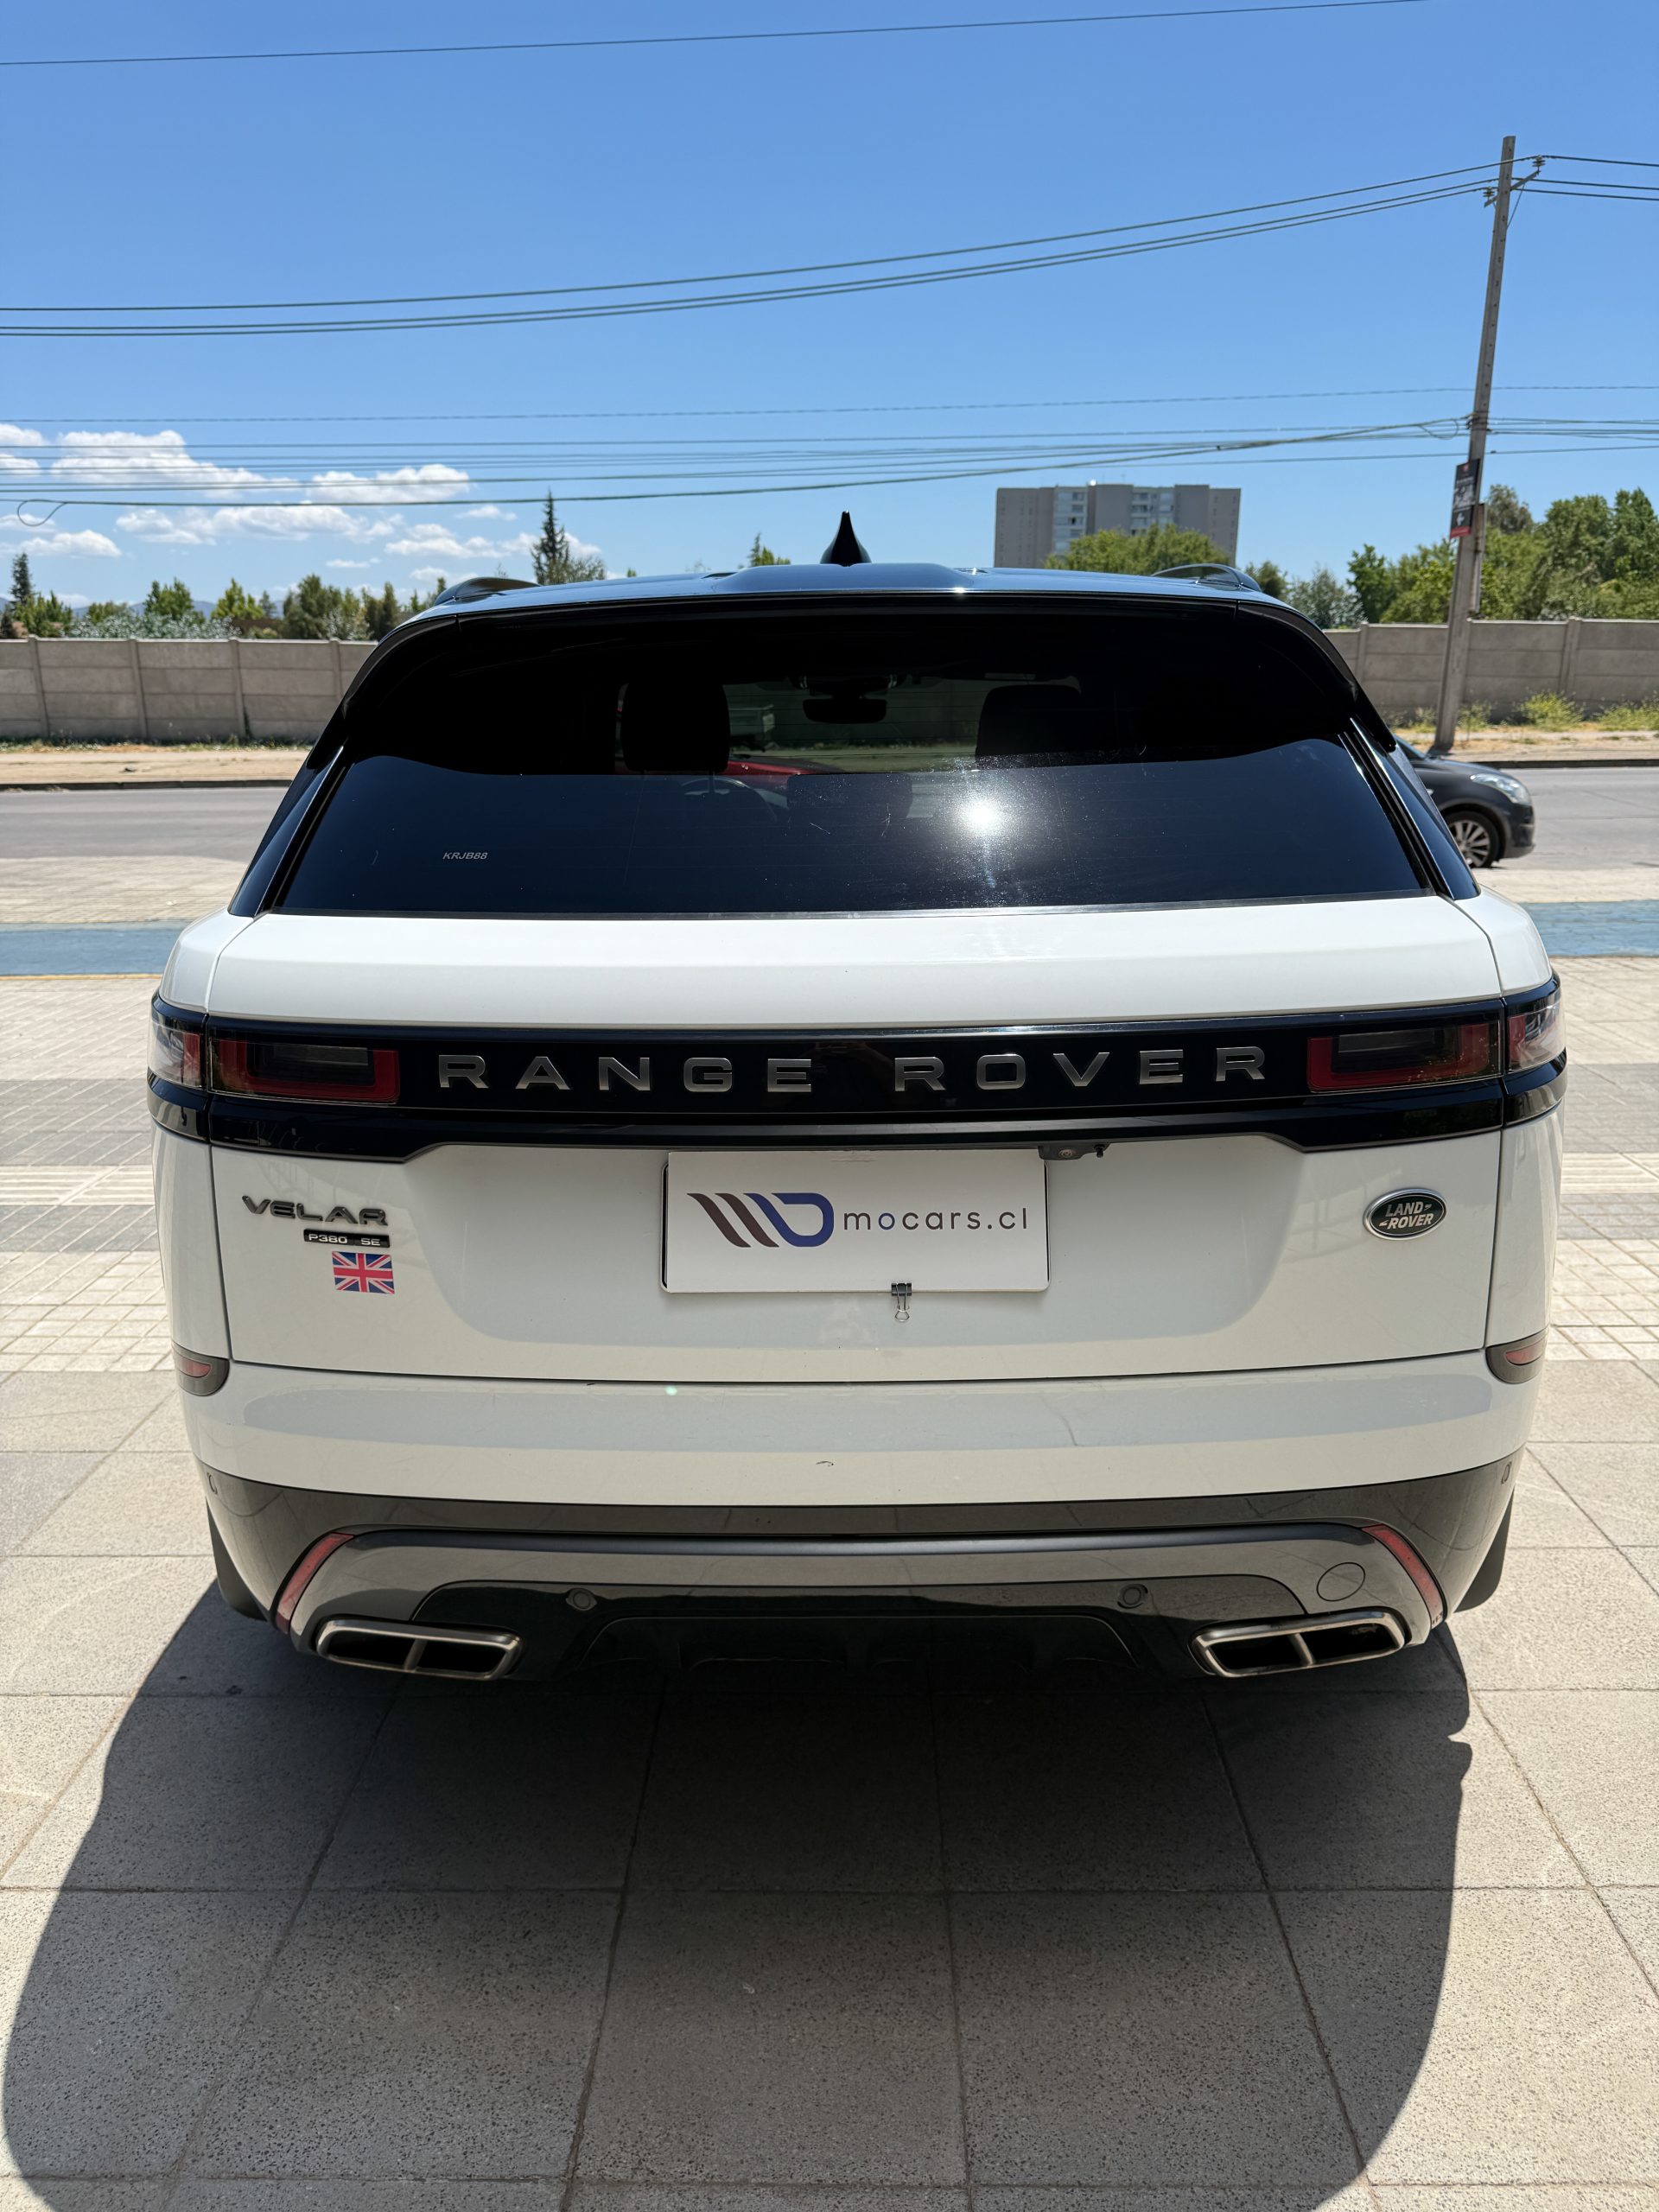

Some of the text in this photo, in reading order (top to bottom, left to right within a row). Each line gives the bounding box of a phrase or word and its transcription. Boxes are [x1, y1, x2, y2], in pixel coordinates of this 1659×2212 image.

[438, 1046, 1266, 1093] RANGE ROVER
[241, 1195, 389, 1226] VELAR
[843, 1206, 1027, 1231] mocars.cl
[1385, 1201, 1424, 1217] LAND
[1387, 1212, 1434, 1230] ROVER
[308, 1233, 381, 1246] P380 SE
